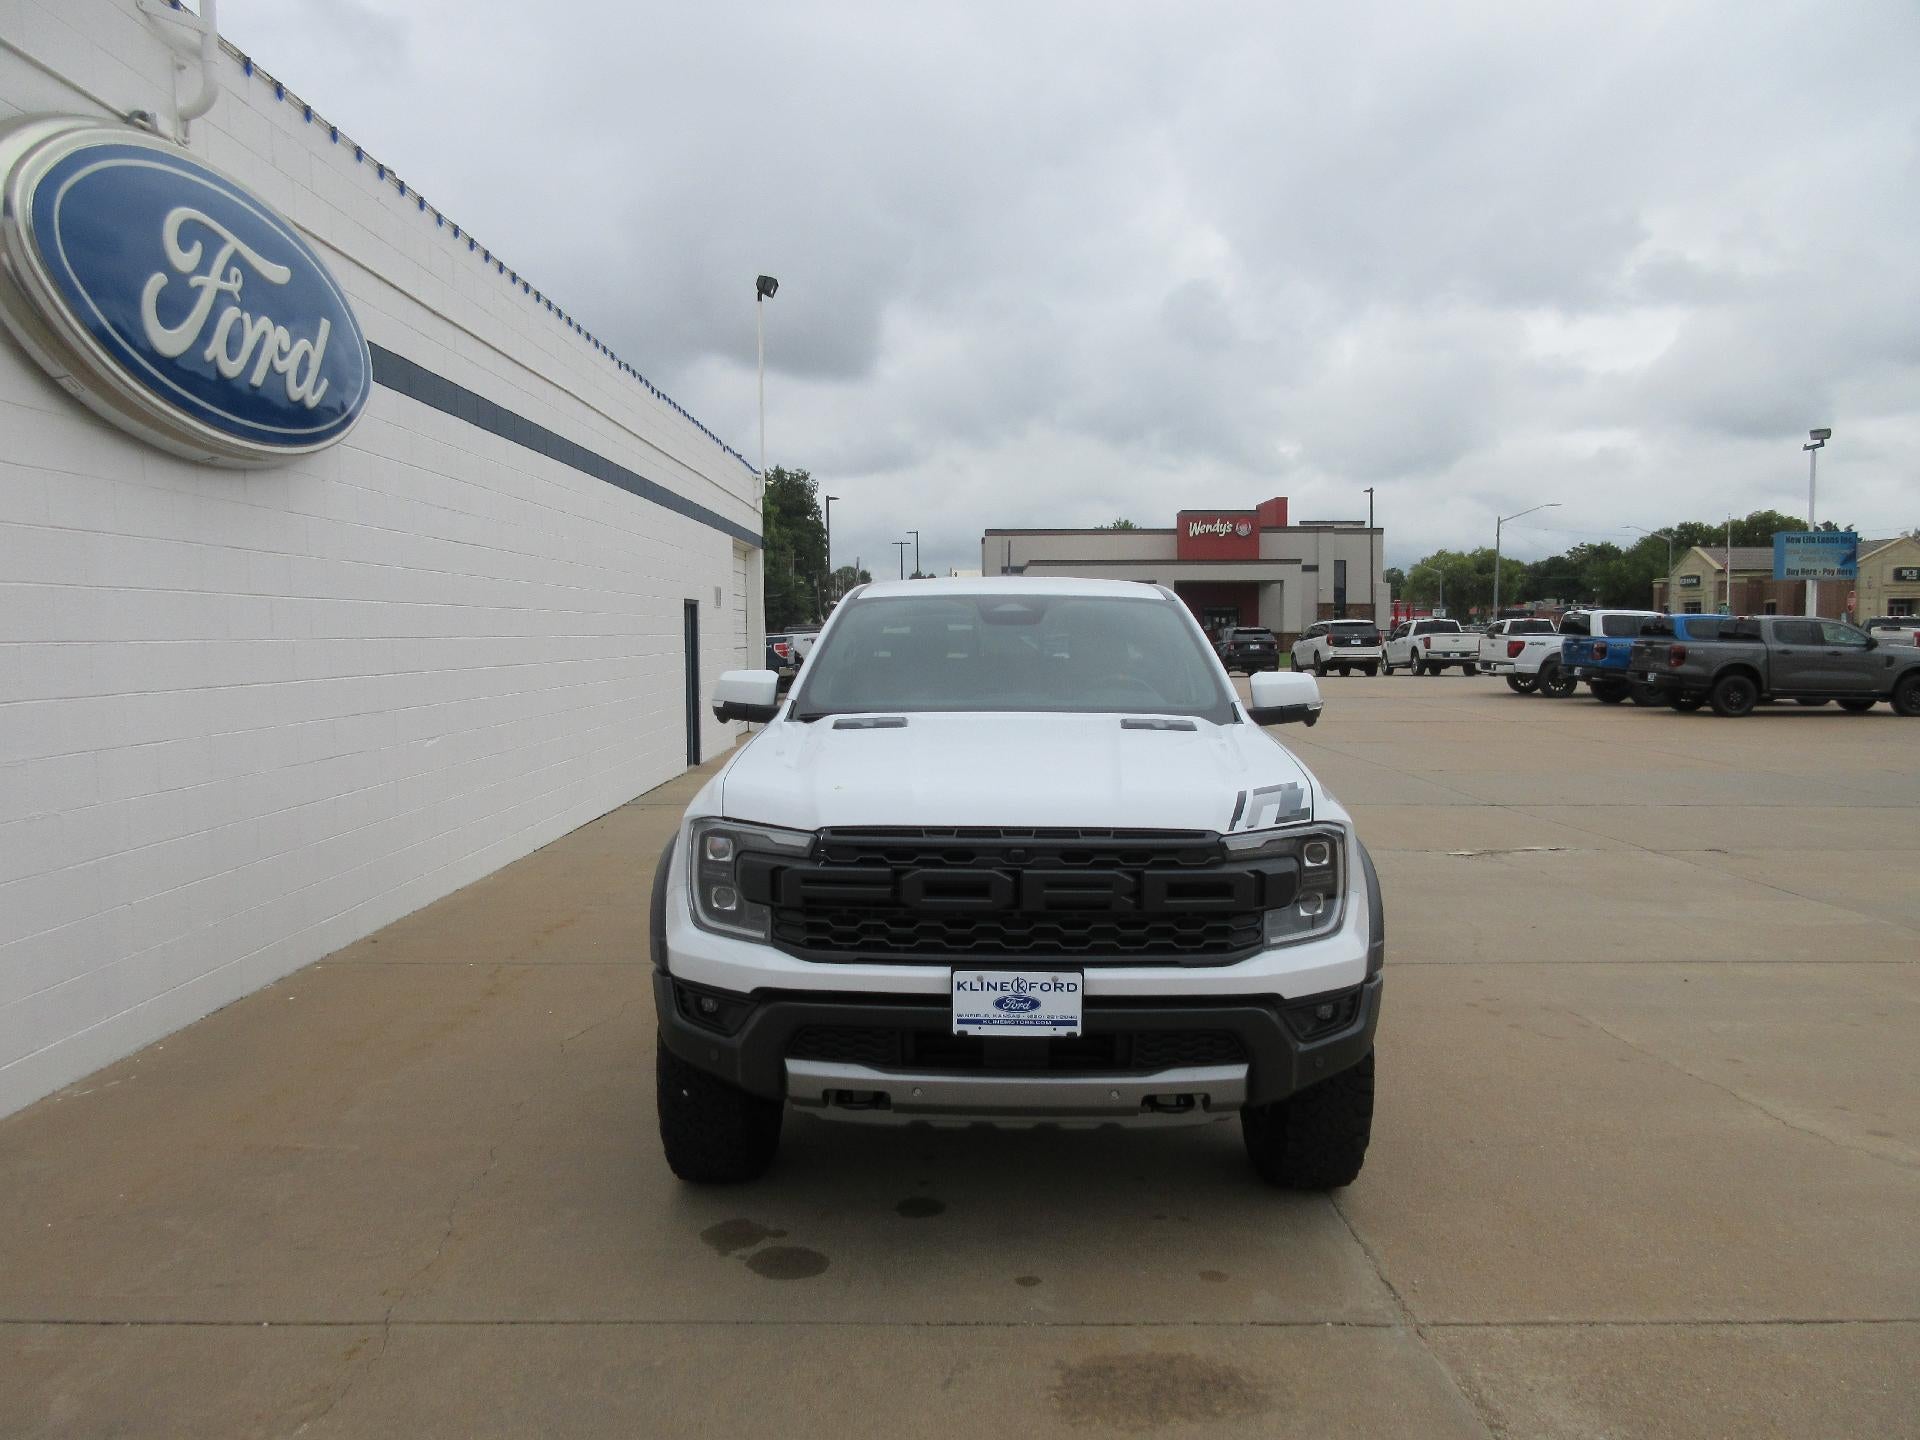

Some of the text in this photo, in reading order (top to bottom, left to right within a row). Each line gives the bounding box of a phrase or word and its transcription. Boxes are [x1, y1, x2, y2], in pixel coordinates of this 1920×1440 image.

[141, 207, 331, 409] Ford
[1189, 518, 1233, 537] Wendy's
[782, 866, 1256, 913] FORD
[957, 981, 1010, 992] KLINE
[1028, 982, 1078, 993] FORD
[1002, 997, 1032, 1010] Ford
